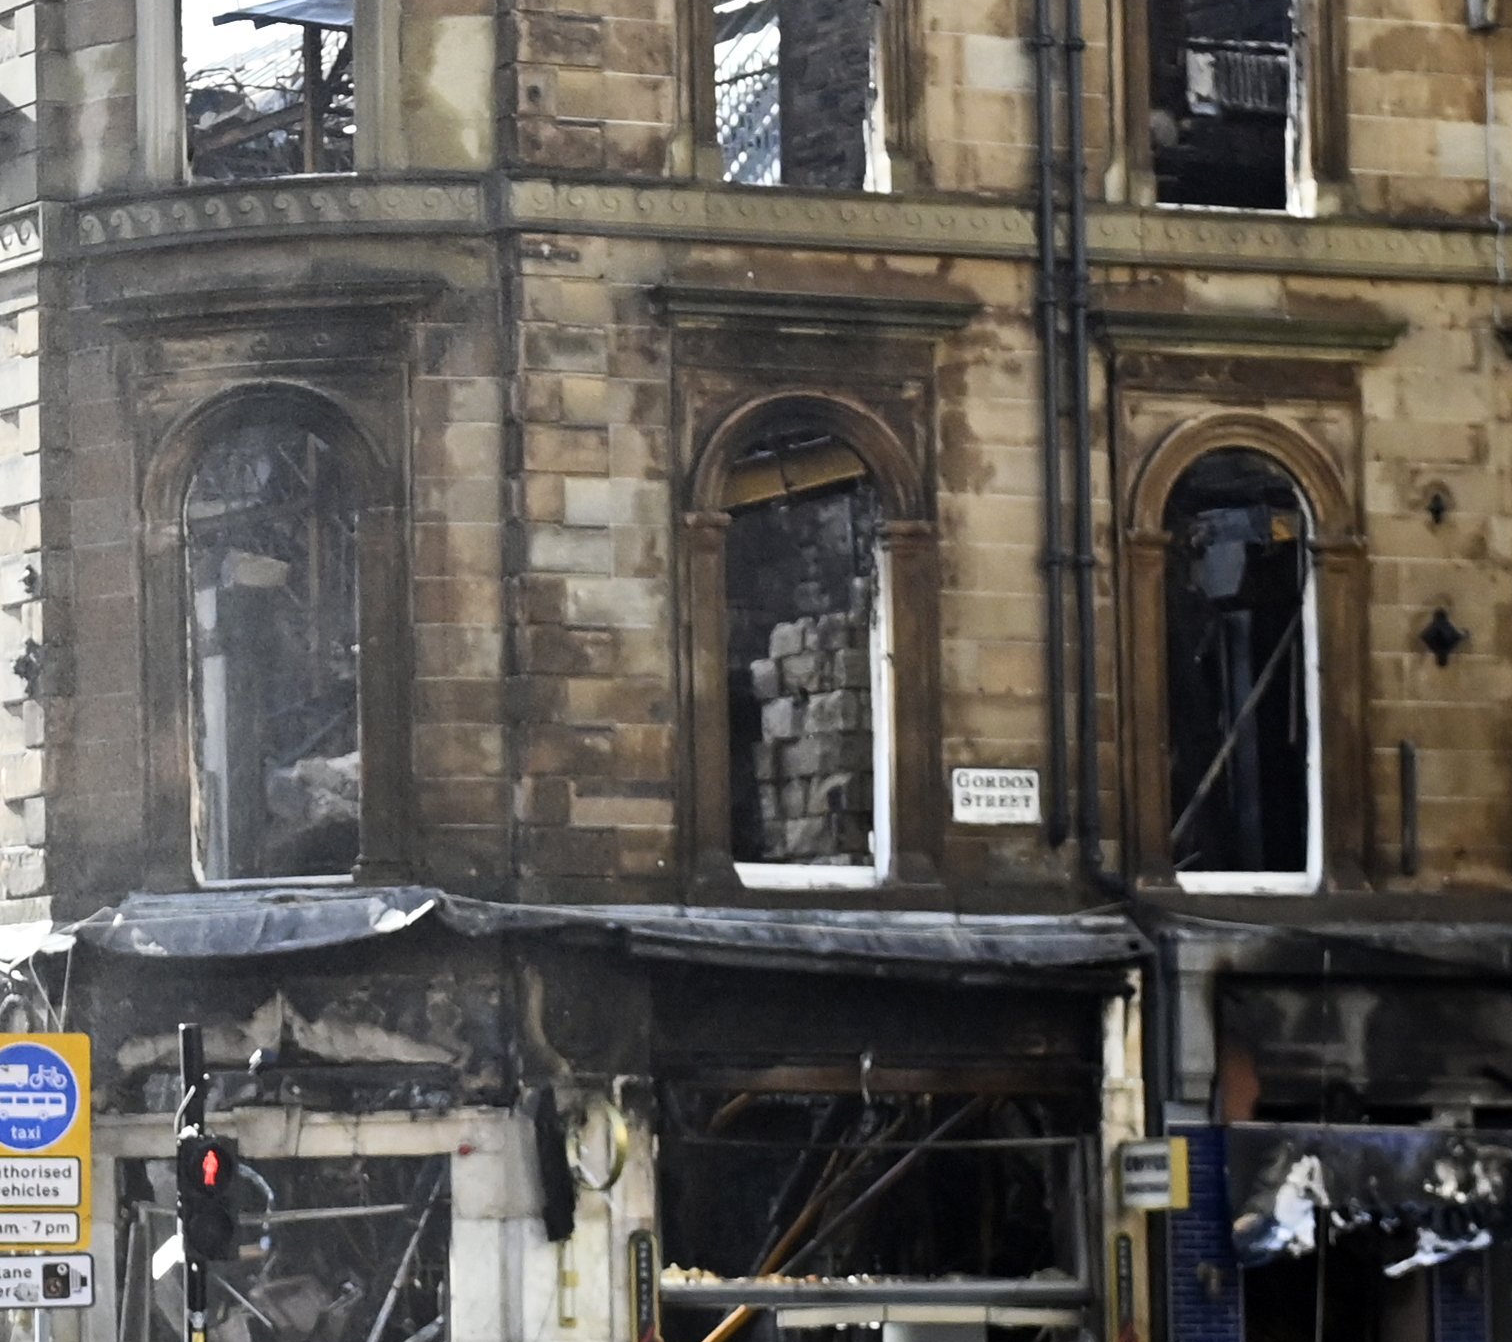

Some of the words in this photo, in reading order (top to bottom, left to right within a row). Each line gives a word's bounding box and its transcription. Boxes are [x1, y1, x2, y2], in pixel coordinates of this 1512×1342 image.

[957, 771, 1034, 788] GORDON
[961, 791, 1031, 808] STREET
[10, 1125, 41, 1140] taxi
[32, 1220, 41, 1234] 7
[45, 1222, 70, 1236] pm
